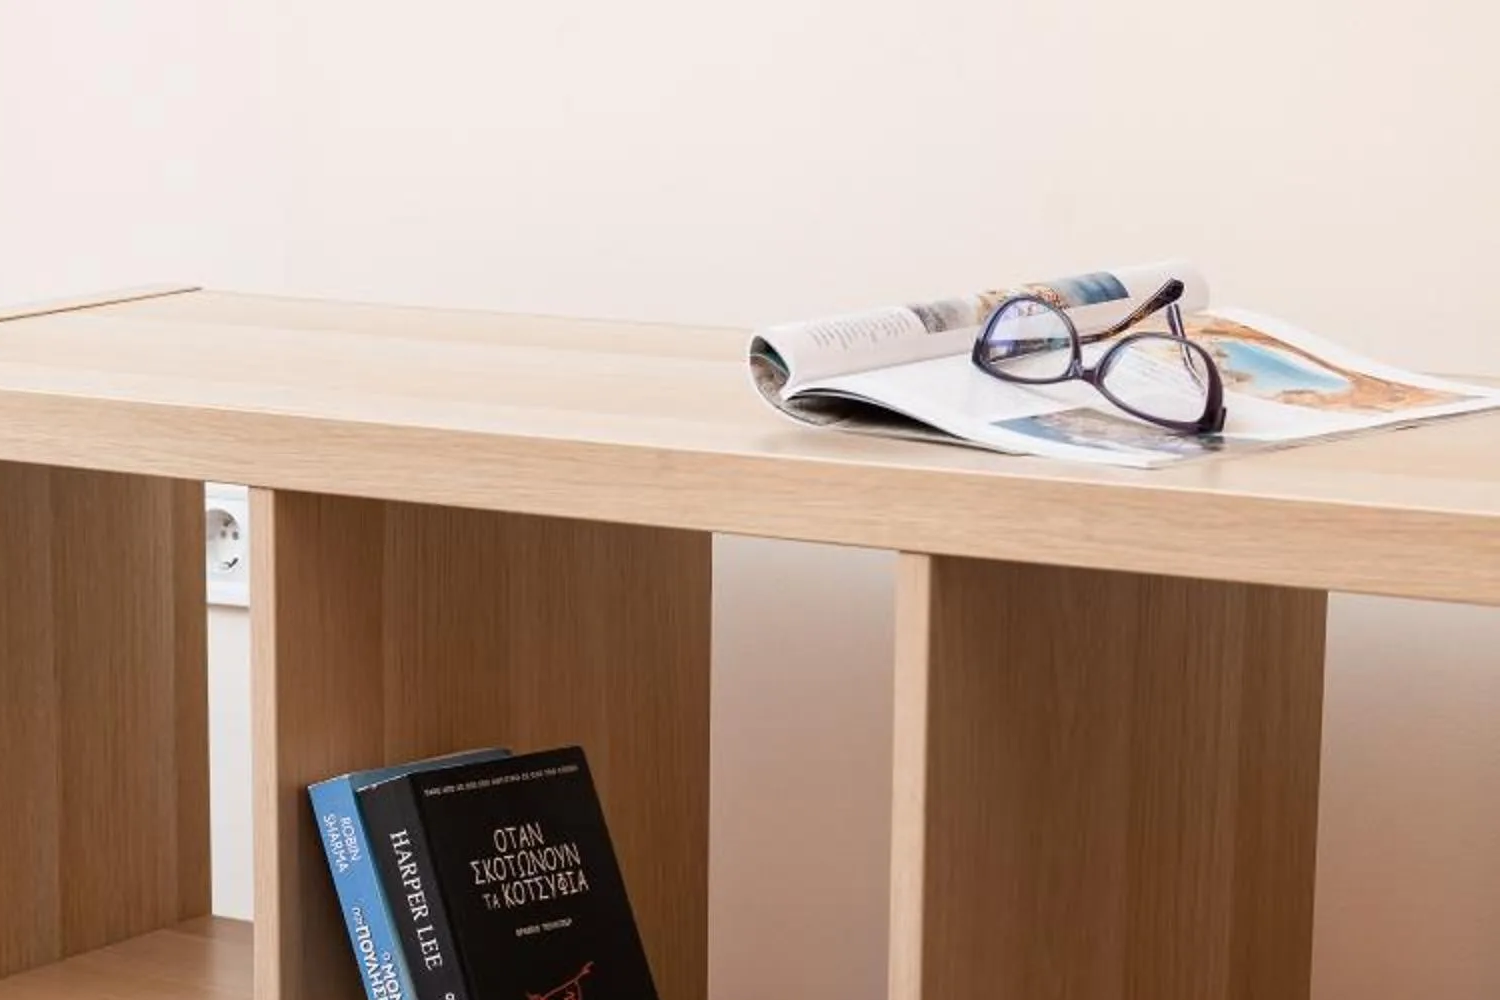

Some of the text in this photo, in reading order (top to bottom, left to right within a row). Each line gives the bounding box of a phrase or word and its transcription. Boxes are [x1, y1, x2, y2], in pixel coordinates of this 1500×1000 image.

[323, 814, 349, 873] SHARMA
[493, 821, 545, 853] ΟΤΑΝ
[470, 842, 581, 885] ΣΚΟΤΩΝΟΥΝ
[389, 829, 443, 971] HARPER LEE
[501, 868, 590, 909] ΚΟΤΣΥΦΙΑ
